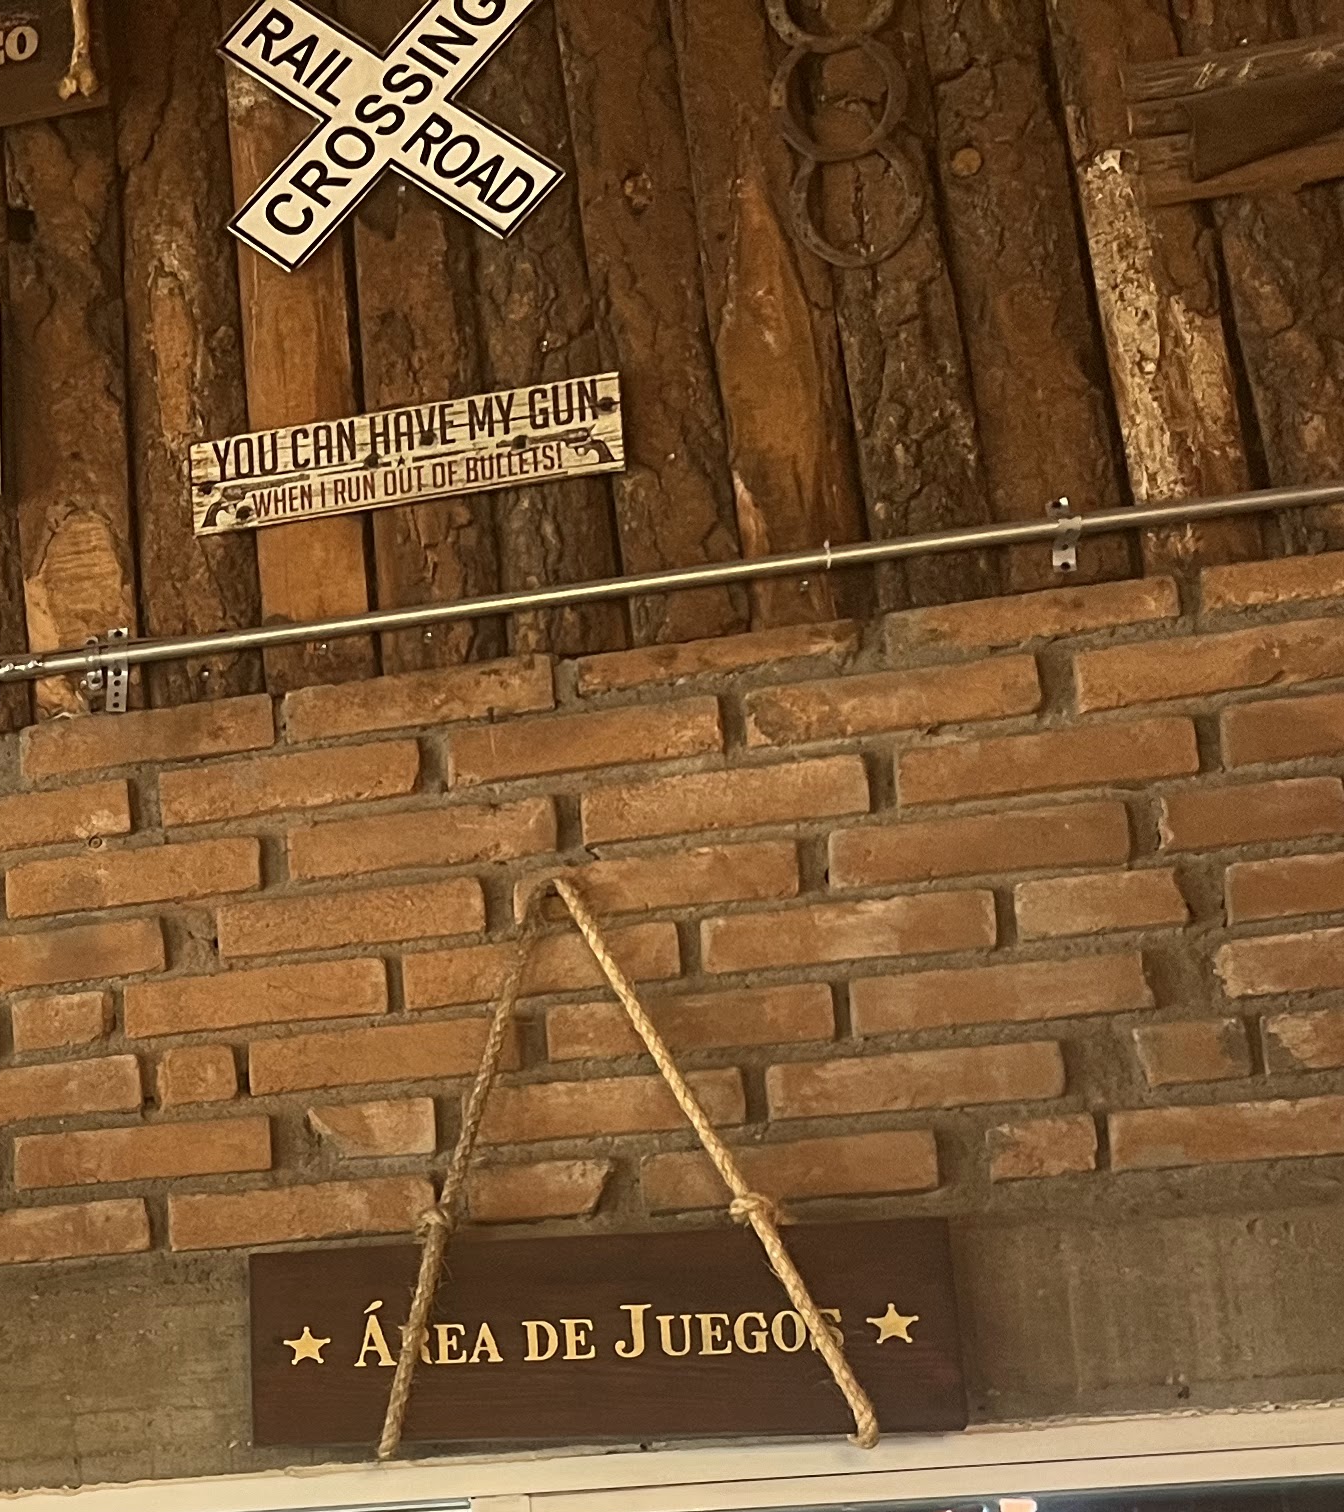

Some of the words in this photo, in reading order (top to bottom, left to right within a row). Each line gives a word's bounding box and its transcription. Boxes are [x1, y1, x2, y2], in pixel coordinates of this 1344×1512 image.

[241, 7, 353, 107] RAIL
[401, 112, 536, 214] ROAD
[265, 0, 504, 236] CROSSING
[212, 436, 279, 482] YOU
[290, 418, 357, 467] CAN
[368, 402, 456, 457] HAVE
[468, 392, 515, 440] MY
[528, 378, 599, 430] GUN
[251, 484, 312, 518] WHEN
[320, 481, 327, 508] I
[333, 473, 377, 507] RUN
[383, 465, 425, 497] OUT
[431, 460, 459, 489] OF
[465, 442, 564, 485] BULLETS!
[523, 1319, 596, 1362] DE
[614, 1303, 844, 1358] JUEGOS
